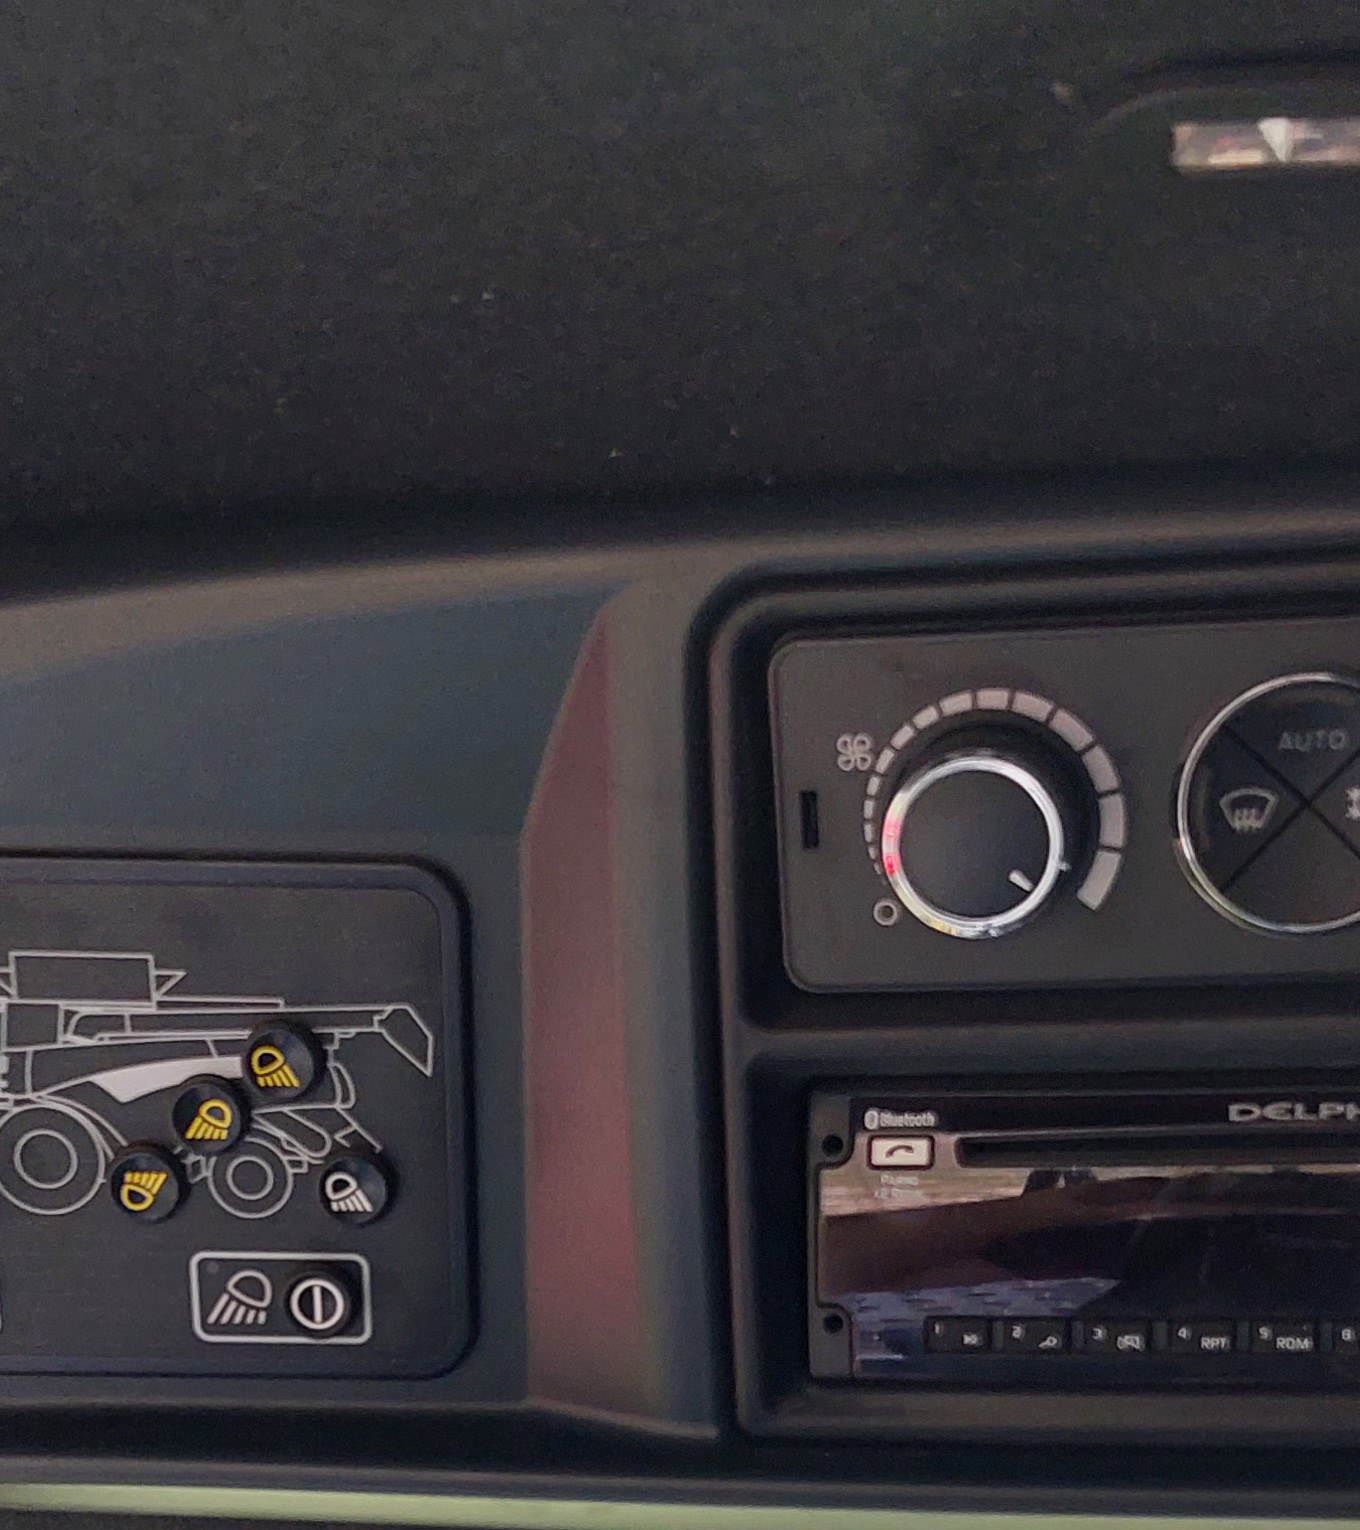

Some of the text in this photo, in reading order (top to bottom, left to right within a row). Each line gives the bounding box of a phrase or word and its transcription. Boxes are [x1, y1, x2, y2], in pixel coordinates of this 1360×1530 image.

[1279, 728, 1350, 752] AUTO
[880, 1111, 936, 1128] Bluetooth
[1177, 1327, 1230, 1350] 4 RPT
